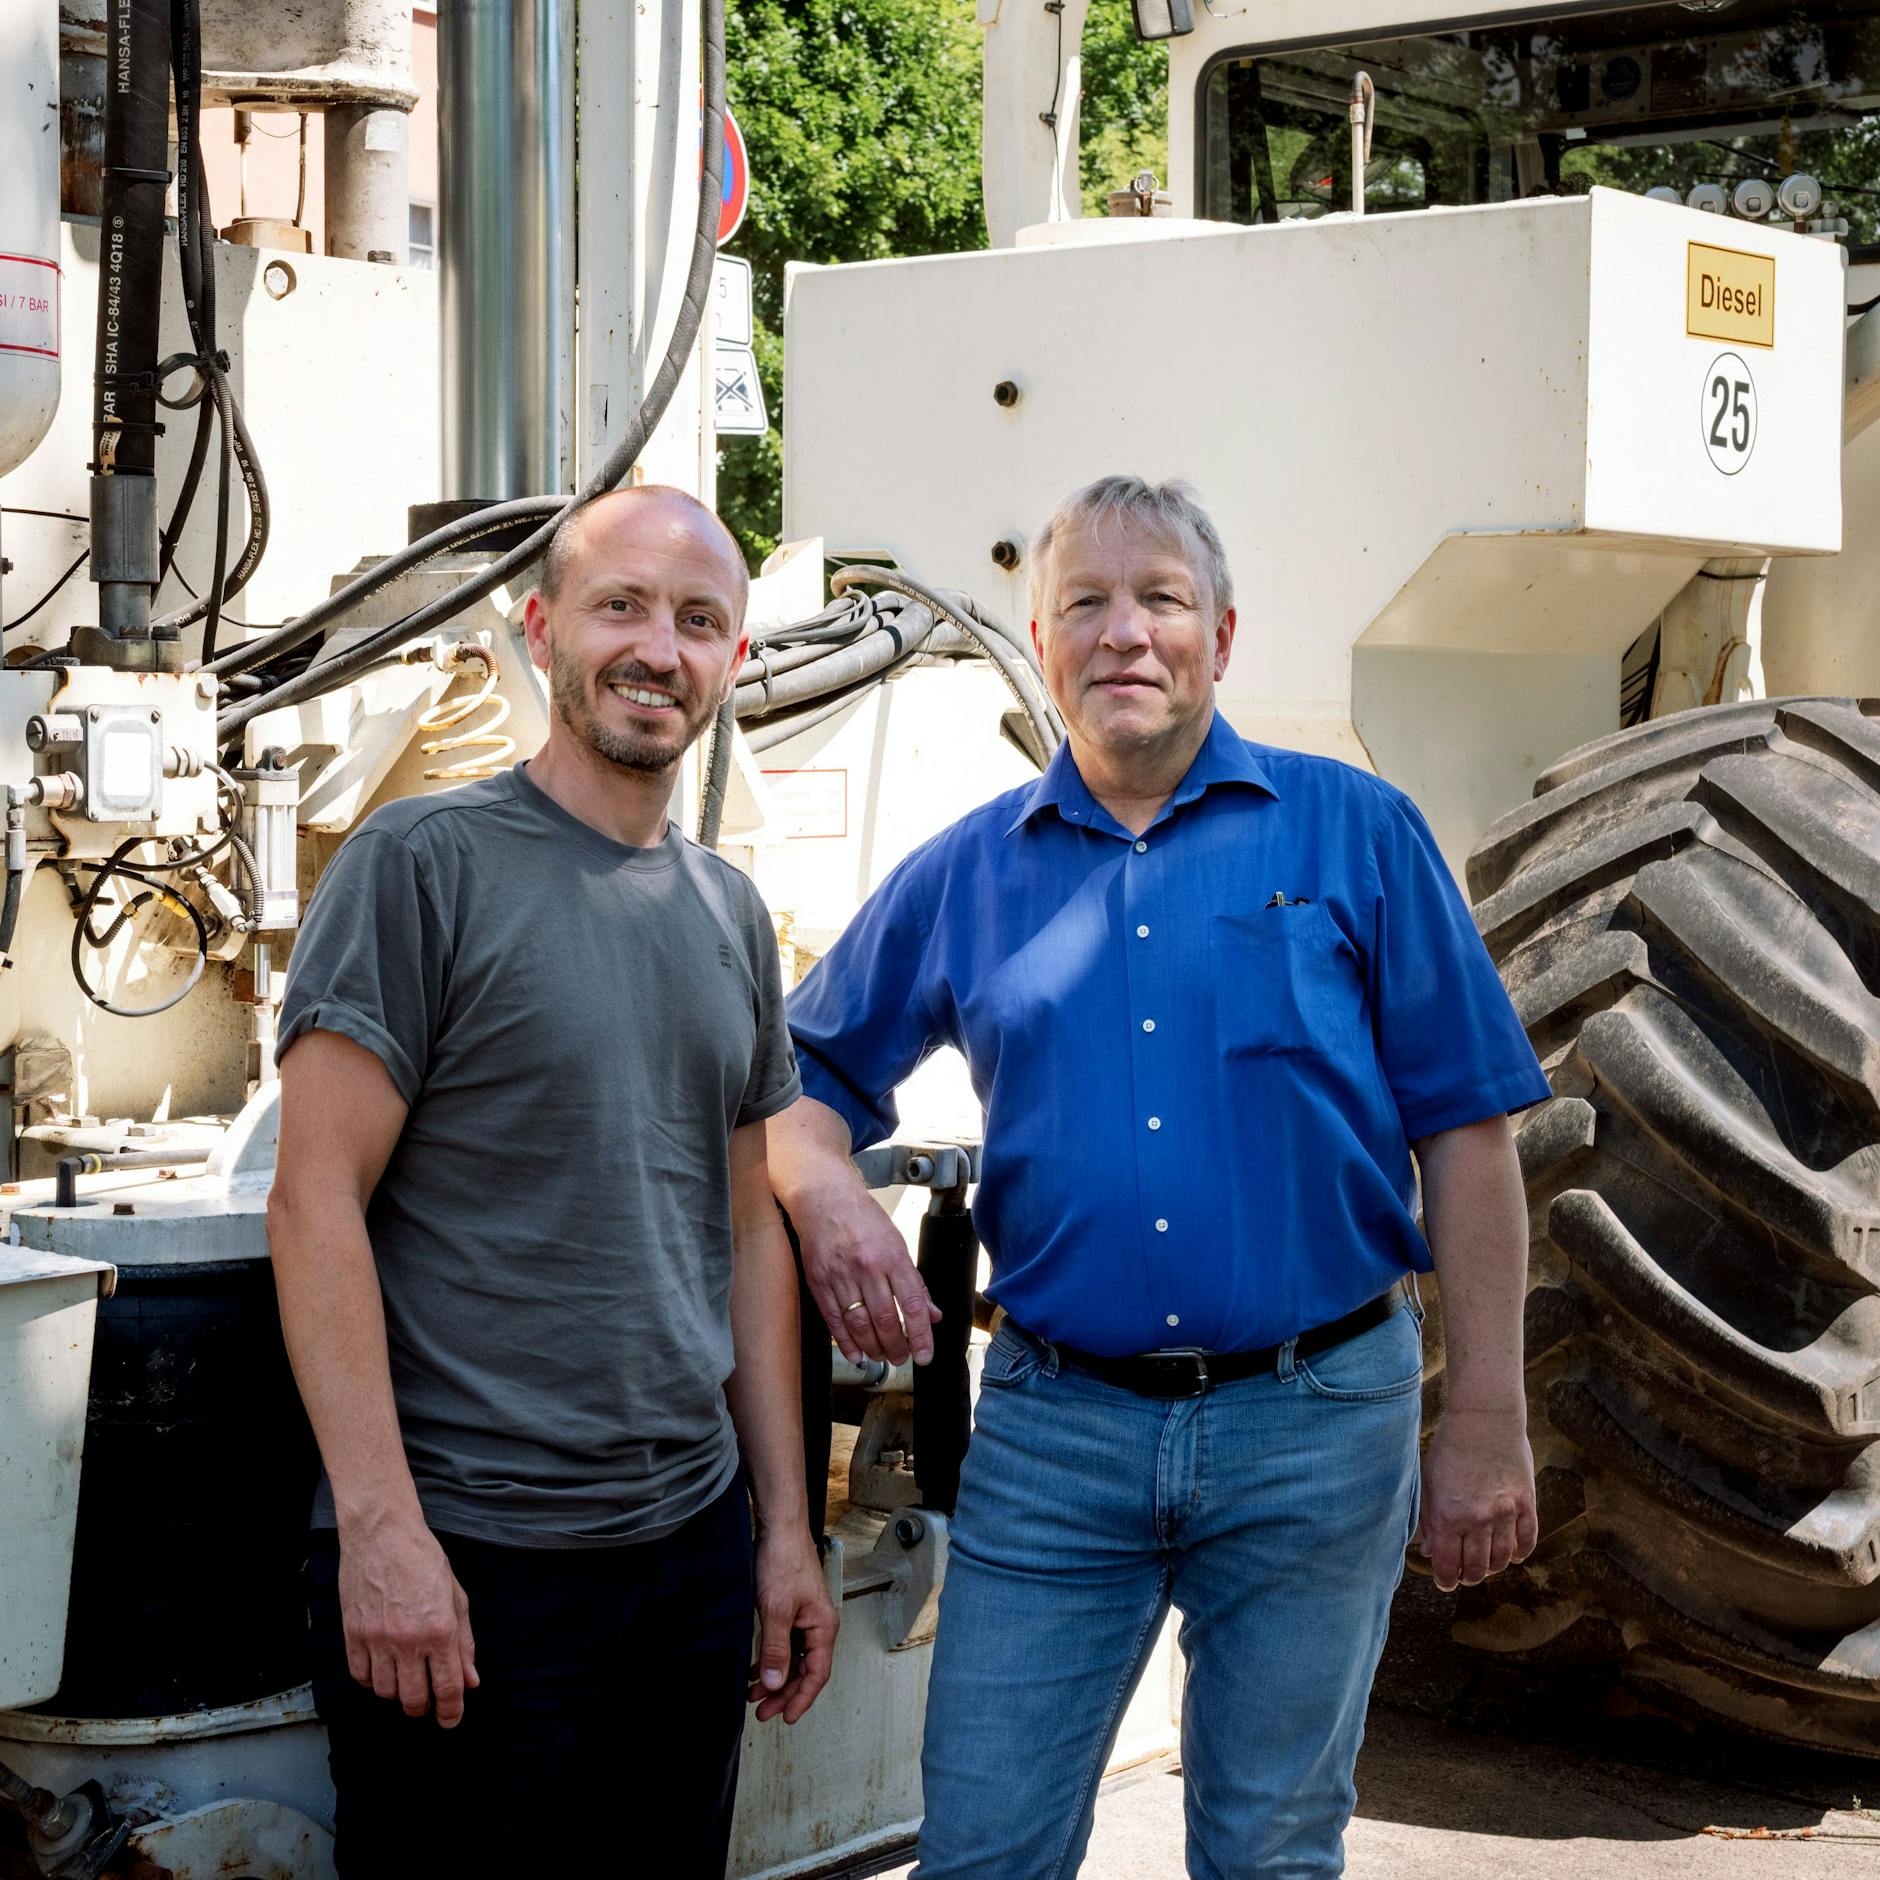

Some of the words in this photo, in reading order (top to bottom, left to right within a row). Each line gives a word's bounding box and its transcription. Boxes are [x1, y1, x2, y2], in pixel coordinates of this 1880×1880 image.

[118, 0, 131, 94] HANSA-FLE
[182, 90, 190, 100] 10
[180, 142, 188, 154] EN
[180, 192, 188, 247] HANSA-FLEX
[110, 233, 124, 273] 4Q18
[19, 297, 26, 309] 7
[29, 297, 49, 313] BAR
[107, 277, 121, 337] IC-84/43
[1700, 273, 1762, 317] Diesel
[1709, 375, 1750, 453] 25
[236, 541, 260, 580] HANSA-FLEX
[956, 620, 963, 630] 12
[962, 625, 972, 637] WP
